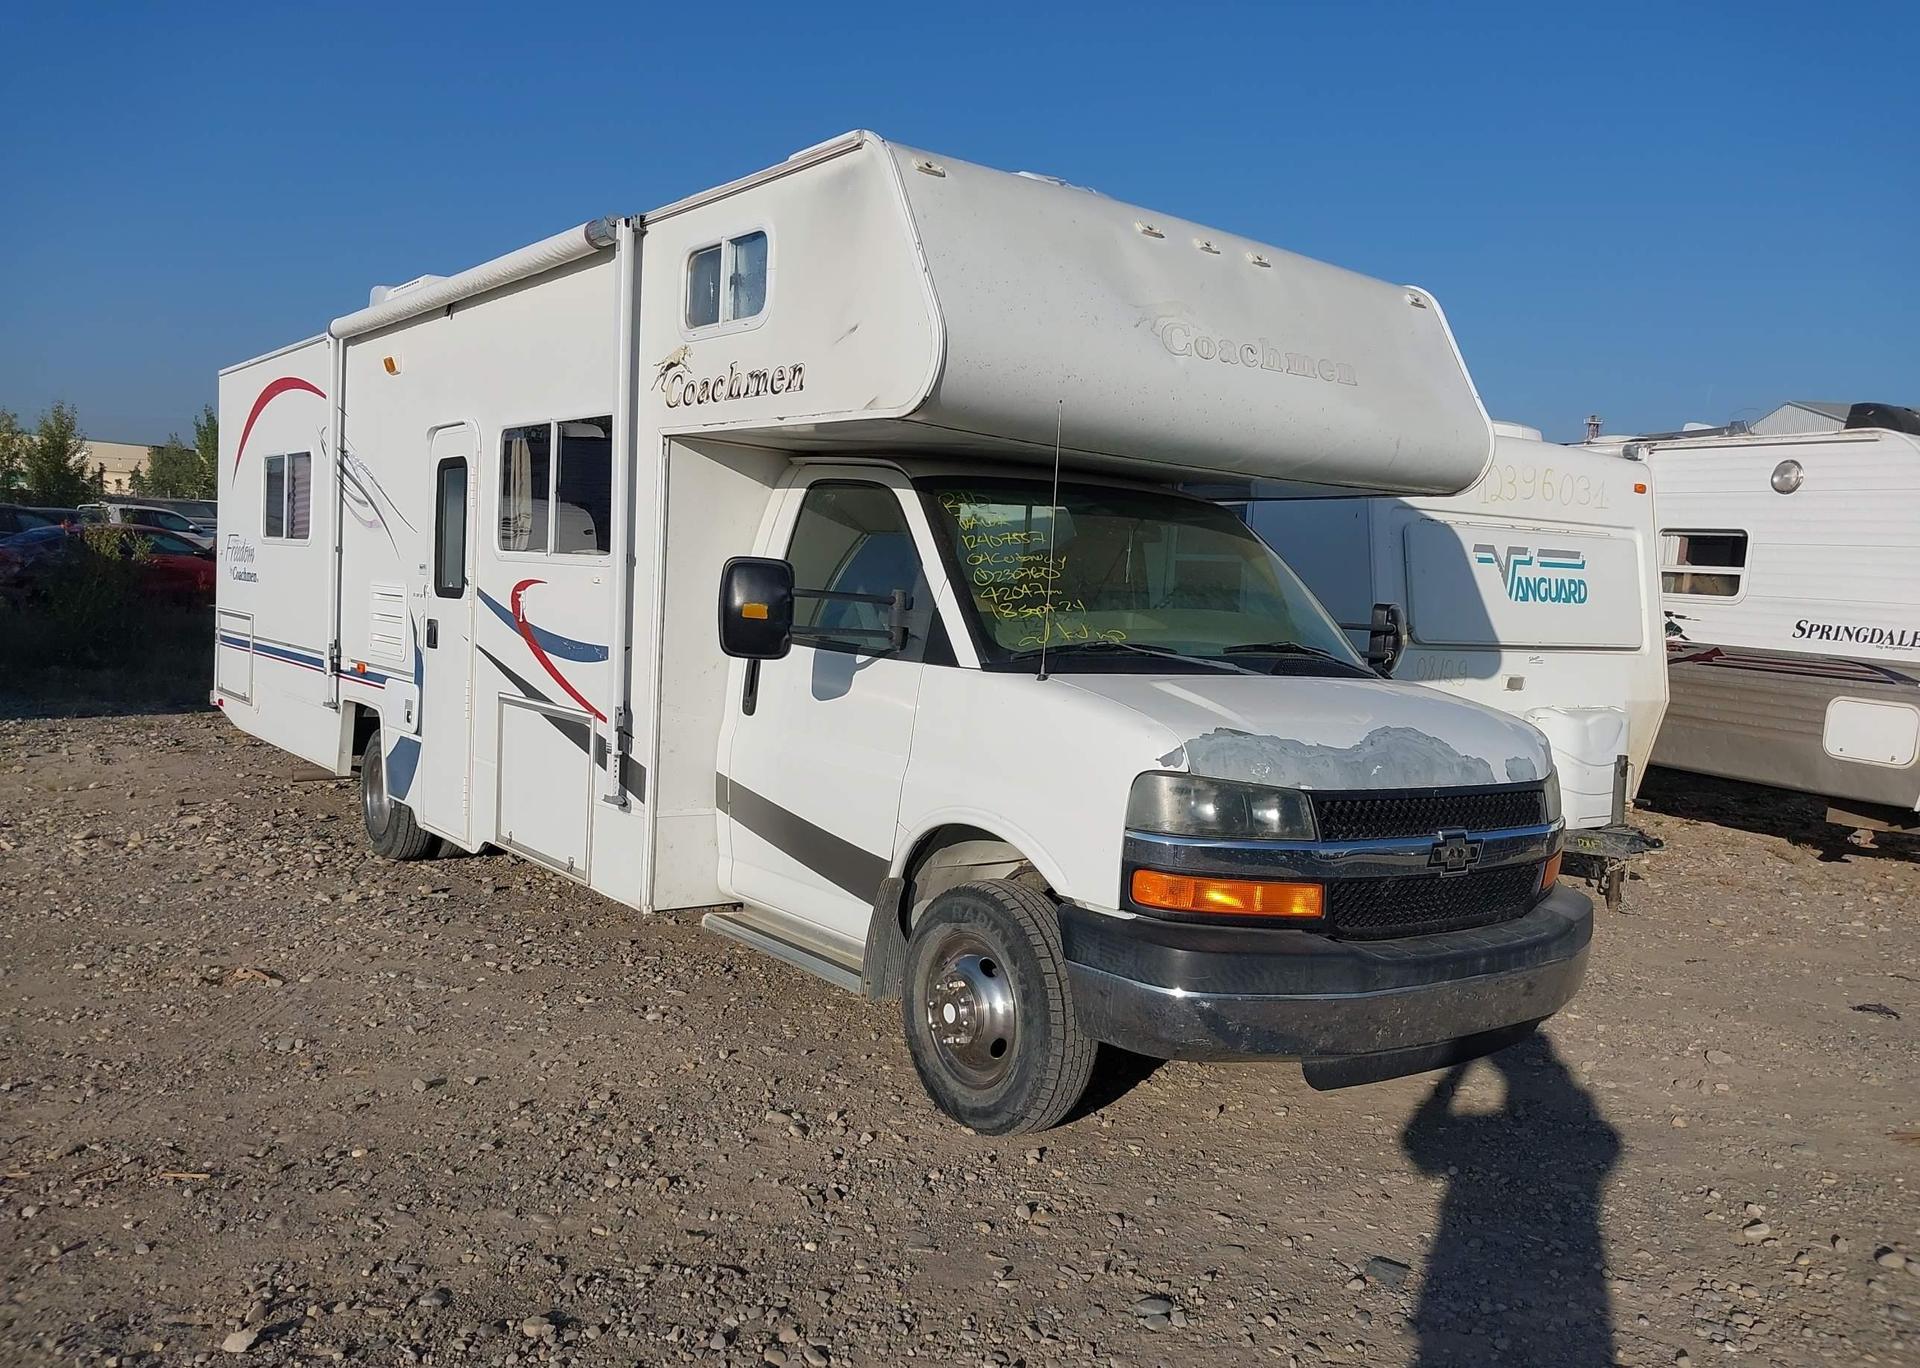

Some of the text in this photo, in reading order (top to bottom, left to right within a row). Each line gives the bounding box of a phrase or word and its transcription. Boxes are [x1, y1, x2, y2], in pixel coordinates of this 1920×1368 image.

[1161, 322, 1358, 387] Coachmen
[665, 361, 806, 408] Coachmen
[1791, 618, 1920, 647] SPRINGDALE
